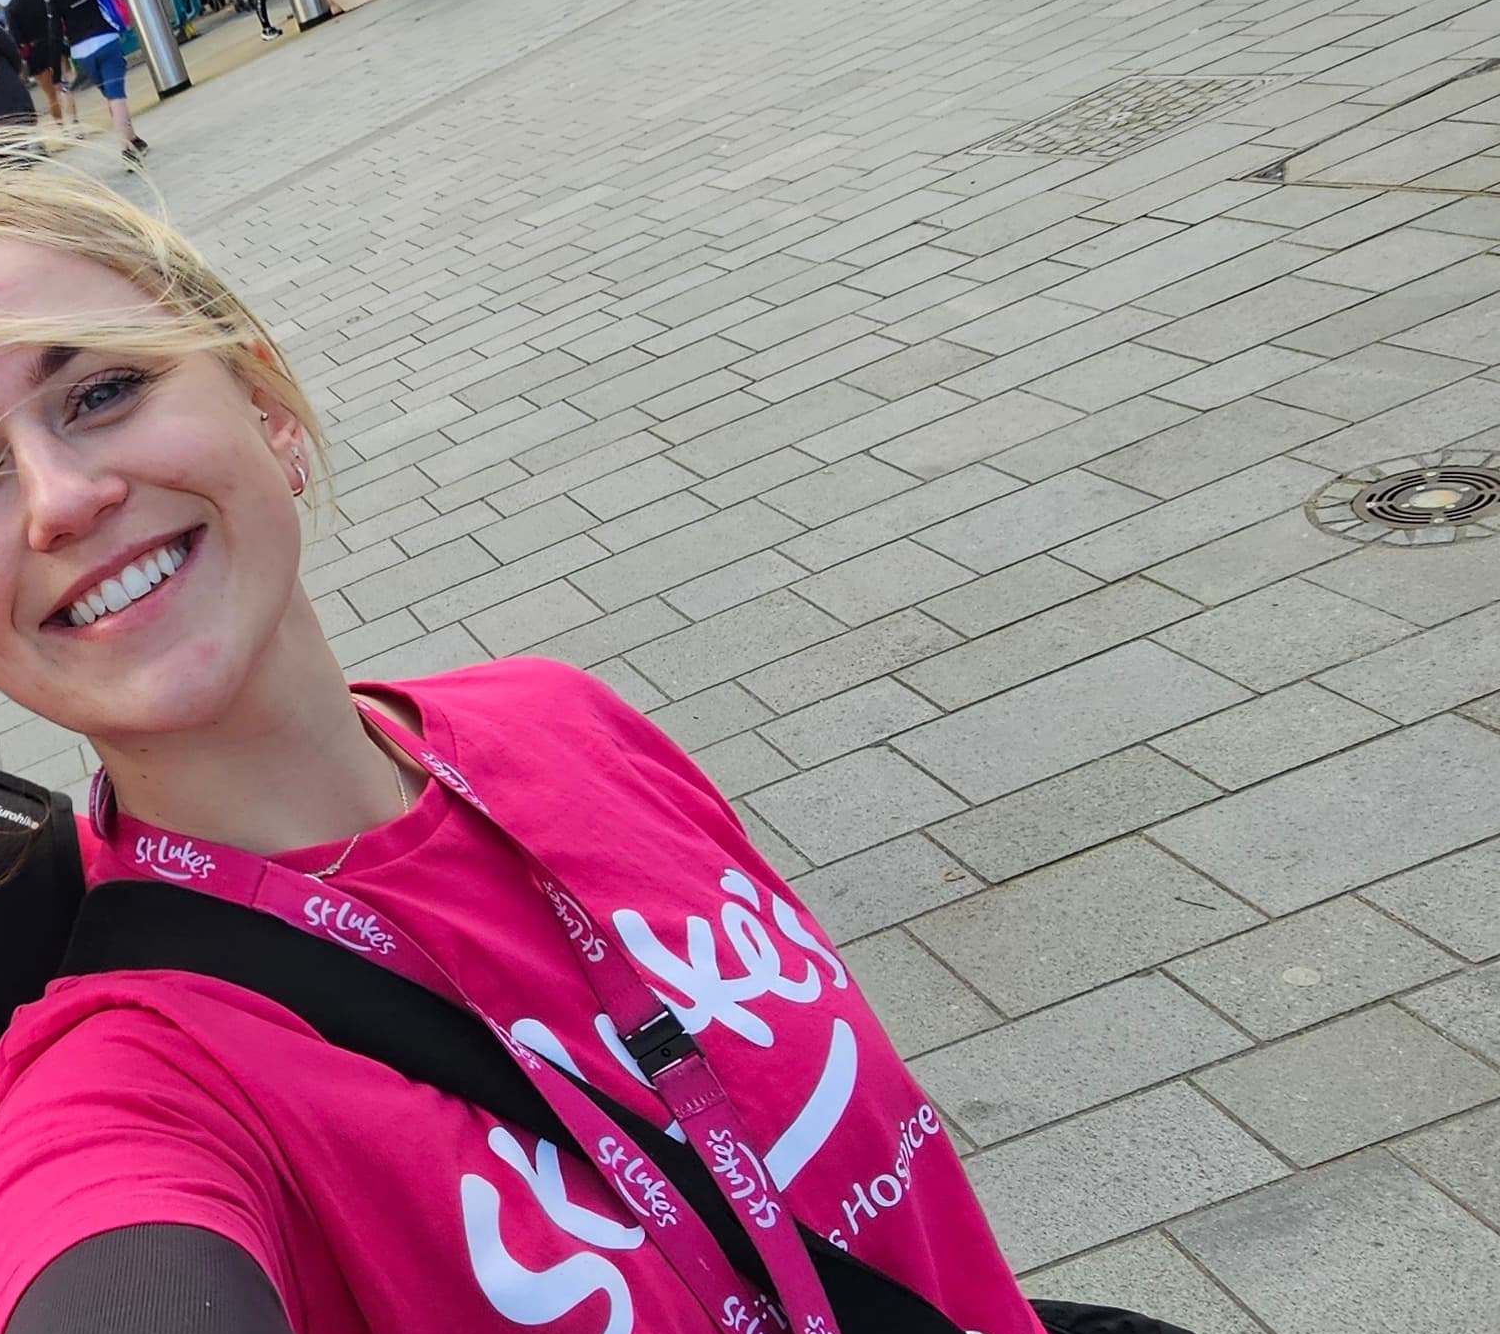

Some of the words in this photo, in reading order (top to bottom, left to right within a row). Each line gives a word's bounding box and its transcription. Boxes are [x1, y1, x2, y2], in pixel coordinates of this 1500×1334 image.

[134, 834, 162, 865] St
[156, 835, 217, 880] Luke's
[303, 896, 334, 929] St
[336, 901, 397, 955] Luke's
[597, 1136, 627, 1169] St
[624, 1157, 678, 1227] Luke's
[706, 1128, 757, 1200] Luke's
[748, 1194, 782, 1229] St
[721, 1295, 750, 1332] St
